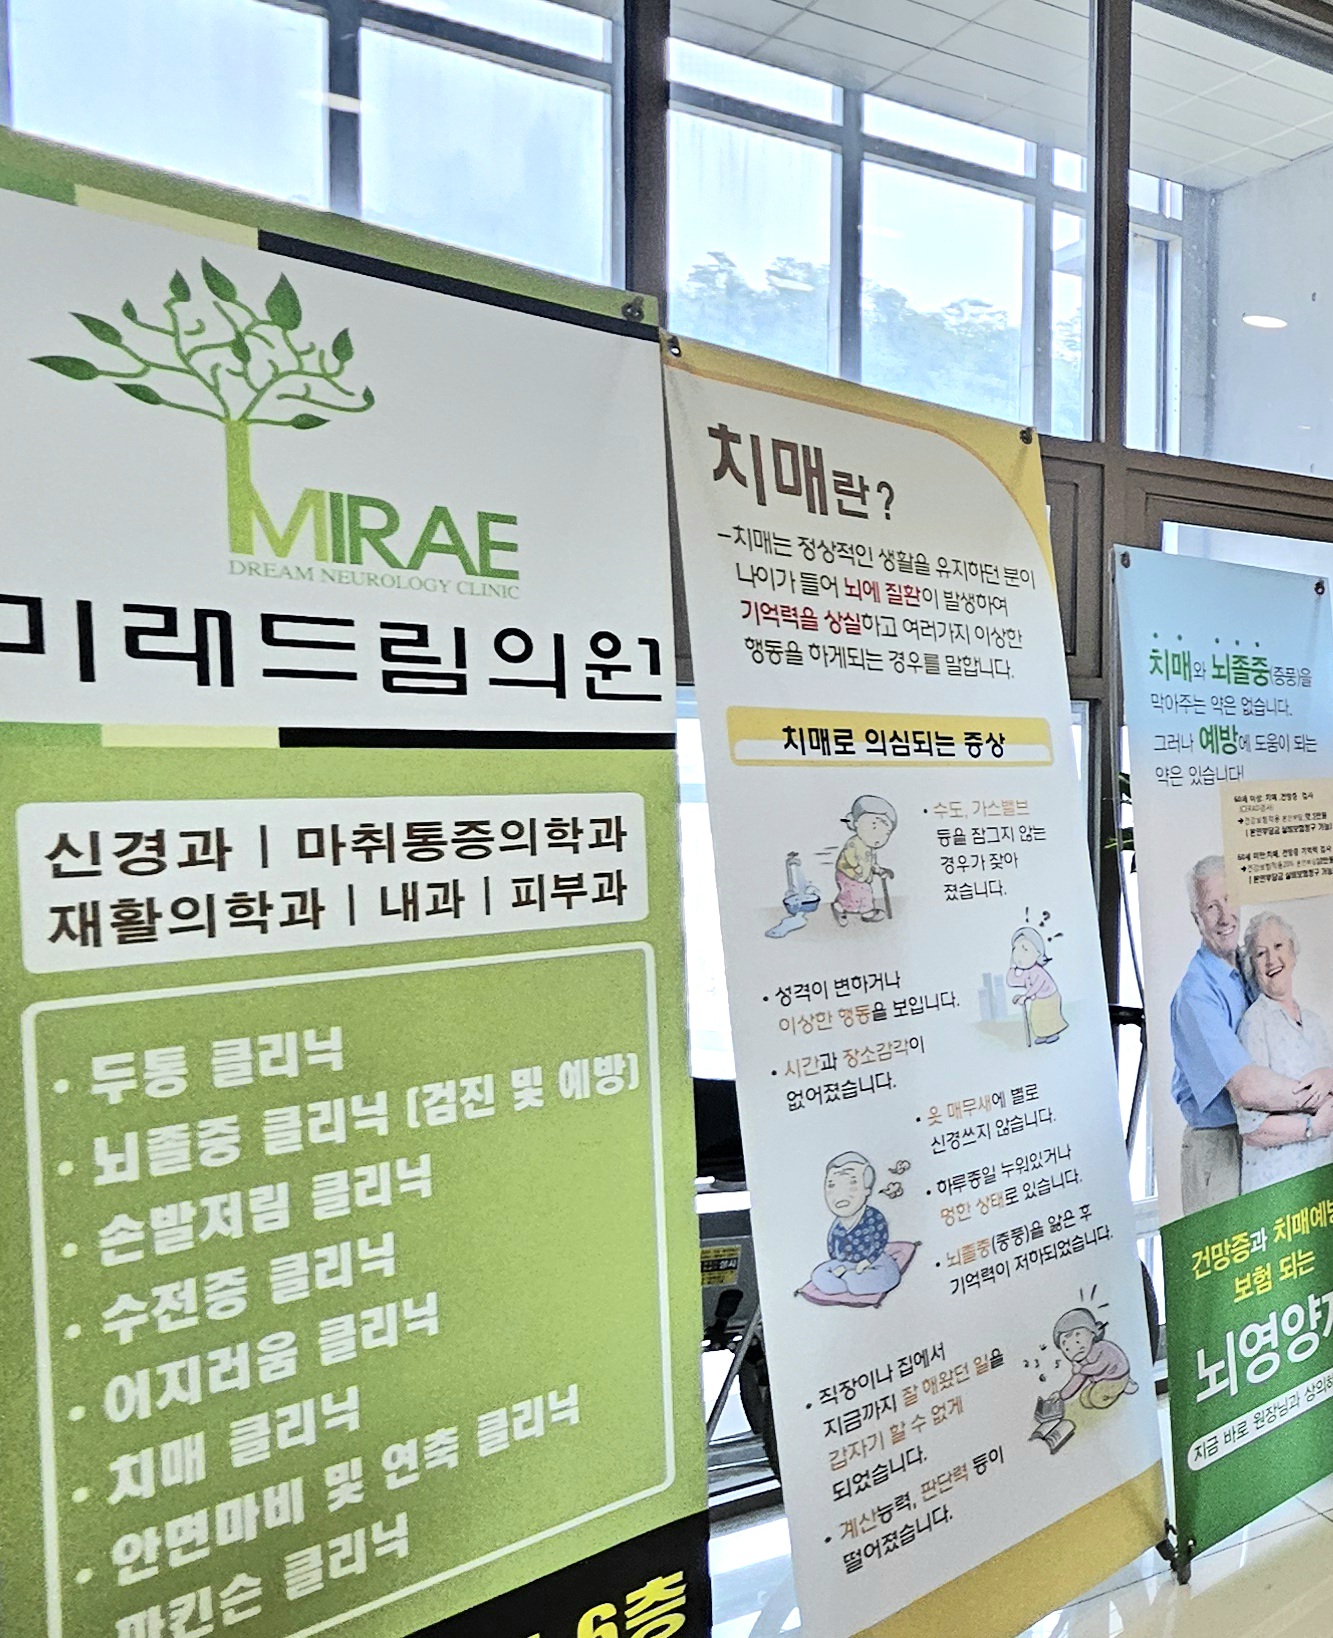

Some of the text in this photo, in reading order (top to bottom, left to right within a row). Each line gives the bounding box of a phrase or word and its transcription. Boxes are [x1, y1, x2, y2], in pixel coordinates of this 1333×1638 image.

[708, 422, 895, 520] 치매란?
[226, 480, 521, 581] MIRAE
[228, 559, 521, 600] DREAM NEUROLOGY CLINIC
[736, 563, 1008, 618] 나이가 들어 뇌에 질환이 발생하여
[798, 536, 874, 568] 정상적인
[880, 547, 930, 575] 생활을
[936, 556, 1000, 585] 유지하던
[1004, 565, 1035, 590] 분이
[0, 593, 663, 702] 미래드림의원
[741, 600, 1023, 650] 기억력을 상실하고 여러가지 이상한
[744, 637, 1014, 679] 행동을 하게되는 경우를 말합니다.
[1149, 649, 1312, 688] 치매와 뇌졸중(중풍)을
[1151, 693, 1293, 716] 막아주는 약은 없습니다.
[783, 725, 1005, 758] 치매로 의심되는 증상
[1154, 725, 1318, 755] 그러나 예방에 도움이 되는
[1156, 765, 1244, 787] 약은 있습니다!
[46, 815, 628, 880] 신경과 마취통증의학과
[937, 825, 1047, 846] 등을 잠그지 않는
[941, 853, 1018, 873] 경우가 잦아
[48, 870, 628, 949] 재활의학과 내과 피부과
[944, 880, 1007, 901] 졌습니다.
[775, 971, 901, 1007] 성격이 변하거나
[778, 991, 960, 1035] 이상한 행동을 보입니다.
[90, 1027, 343, 1104] 두통 클리닉
[93, 1114, 242, 1186] 뇌졸중
[263, 1090, 389, 1155] 클리닉
[511, 1066, 543, 1111] 및
[98, 1154, 433, 1267] 손발저림 클리닉
[1191, 1228, 1268, 1280] 건망증과
[1233, 1250, 1316, 1302] 보험 되는
[101, 1232, 396, 1345] 수전증 클리닉
[103, 1293, 440, 1424] 어지러움 클리닉
[818, 1342, 946, 1406] 직장이나 집에서
[822, 1349, 1005, 1438] 지금까지 잘 해왔던 일을
[107, 1387, 361, 1504] 치매 클리닉
[1194, 1436, 1220, 1462] 지금
[1224, 1420, 1249, 1444] 바로
[1253, 1391, 1300, 1431] 원장님과
[111, 1384, 580, 1586] 안면마비 및 연축 클리닉
[114, 1513, 411, 1638] 파킨슨 클리닉
